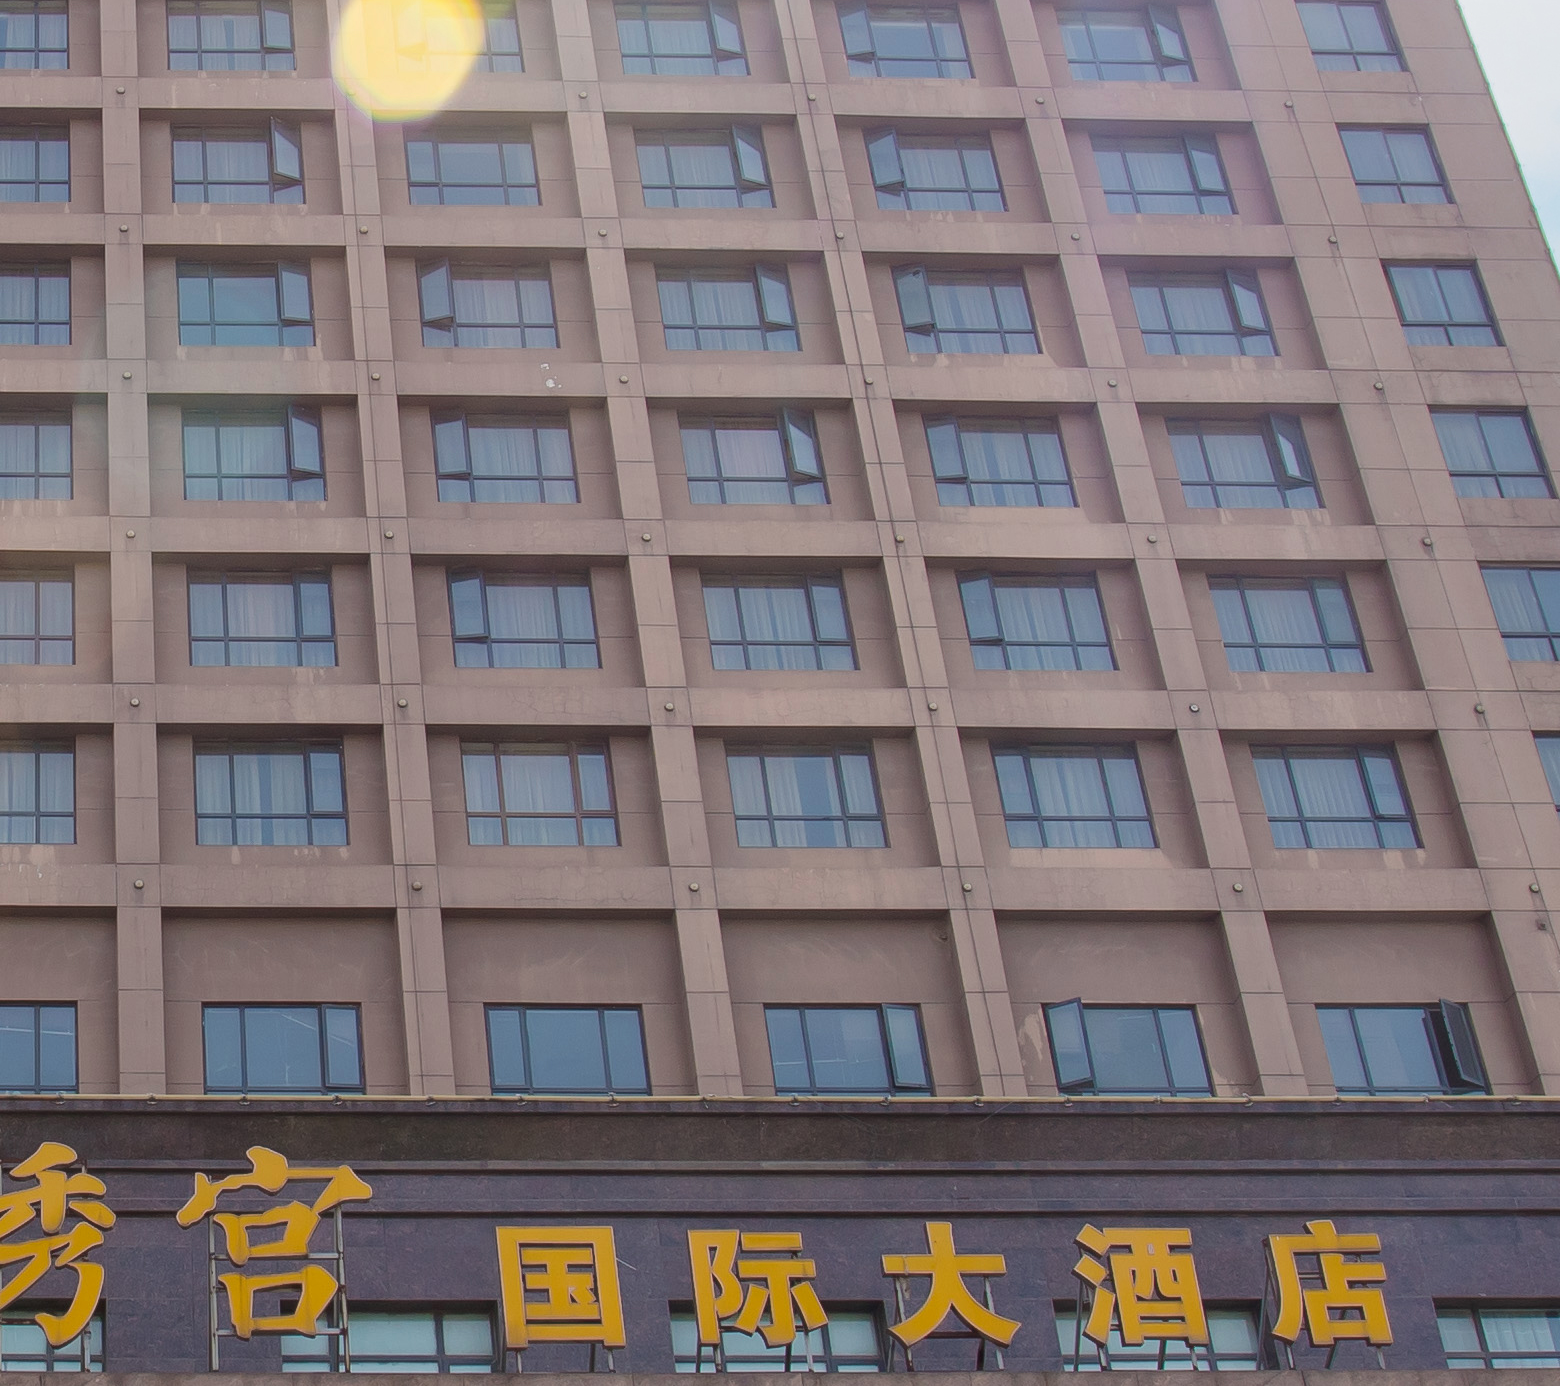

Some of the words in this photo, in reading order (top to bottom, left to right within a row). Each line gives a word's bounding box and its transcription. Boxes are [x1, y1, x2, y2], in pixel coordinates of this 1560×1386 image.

[495, 1218, 1394, 1349] 国际大酒店
